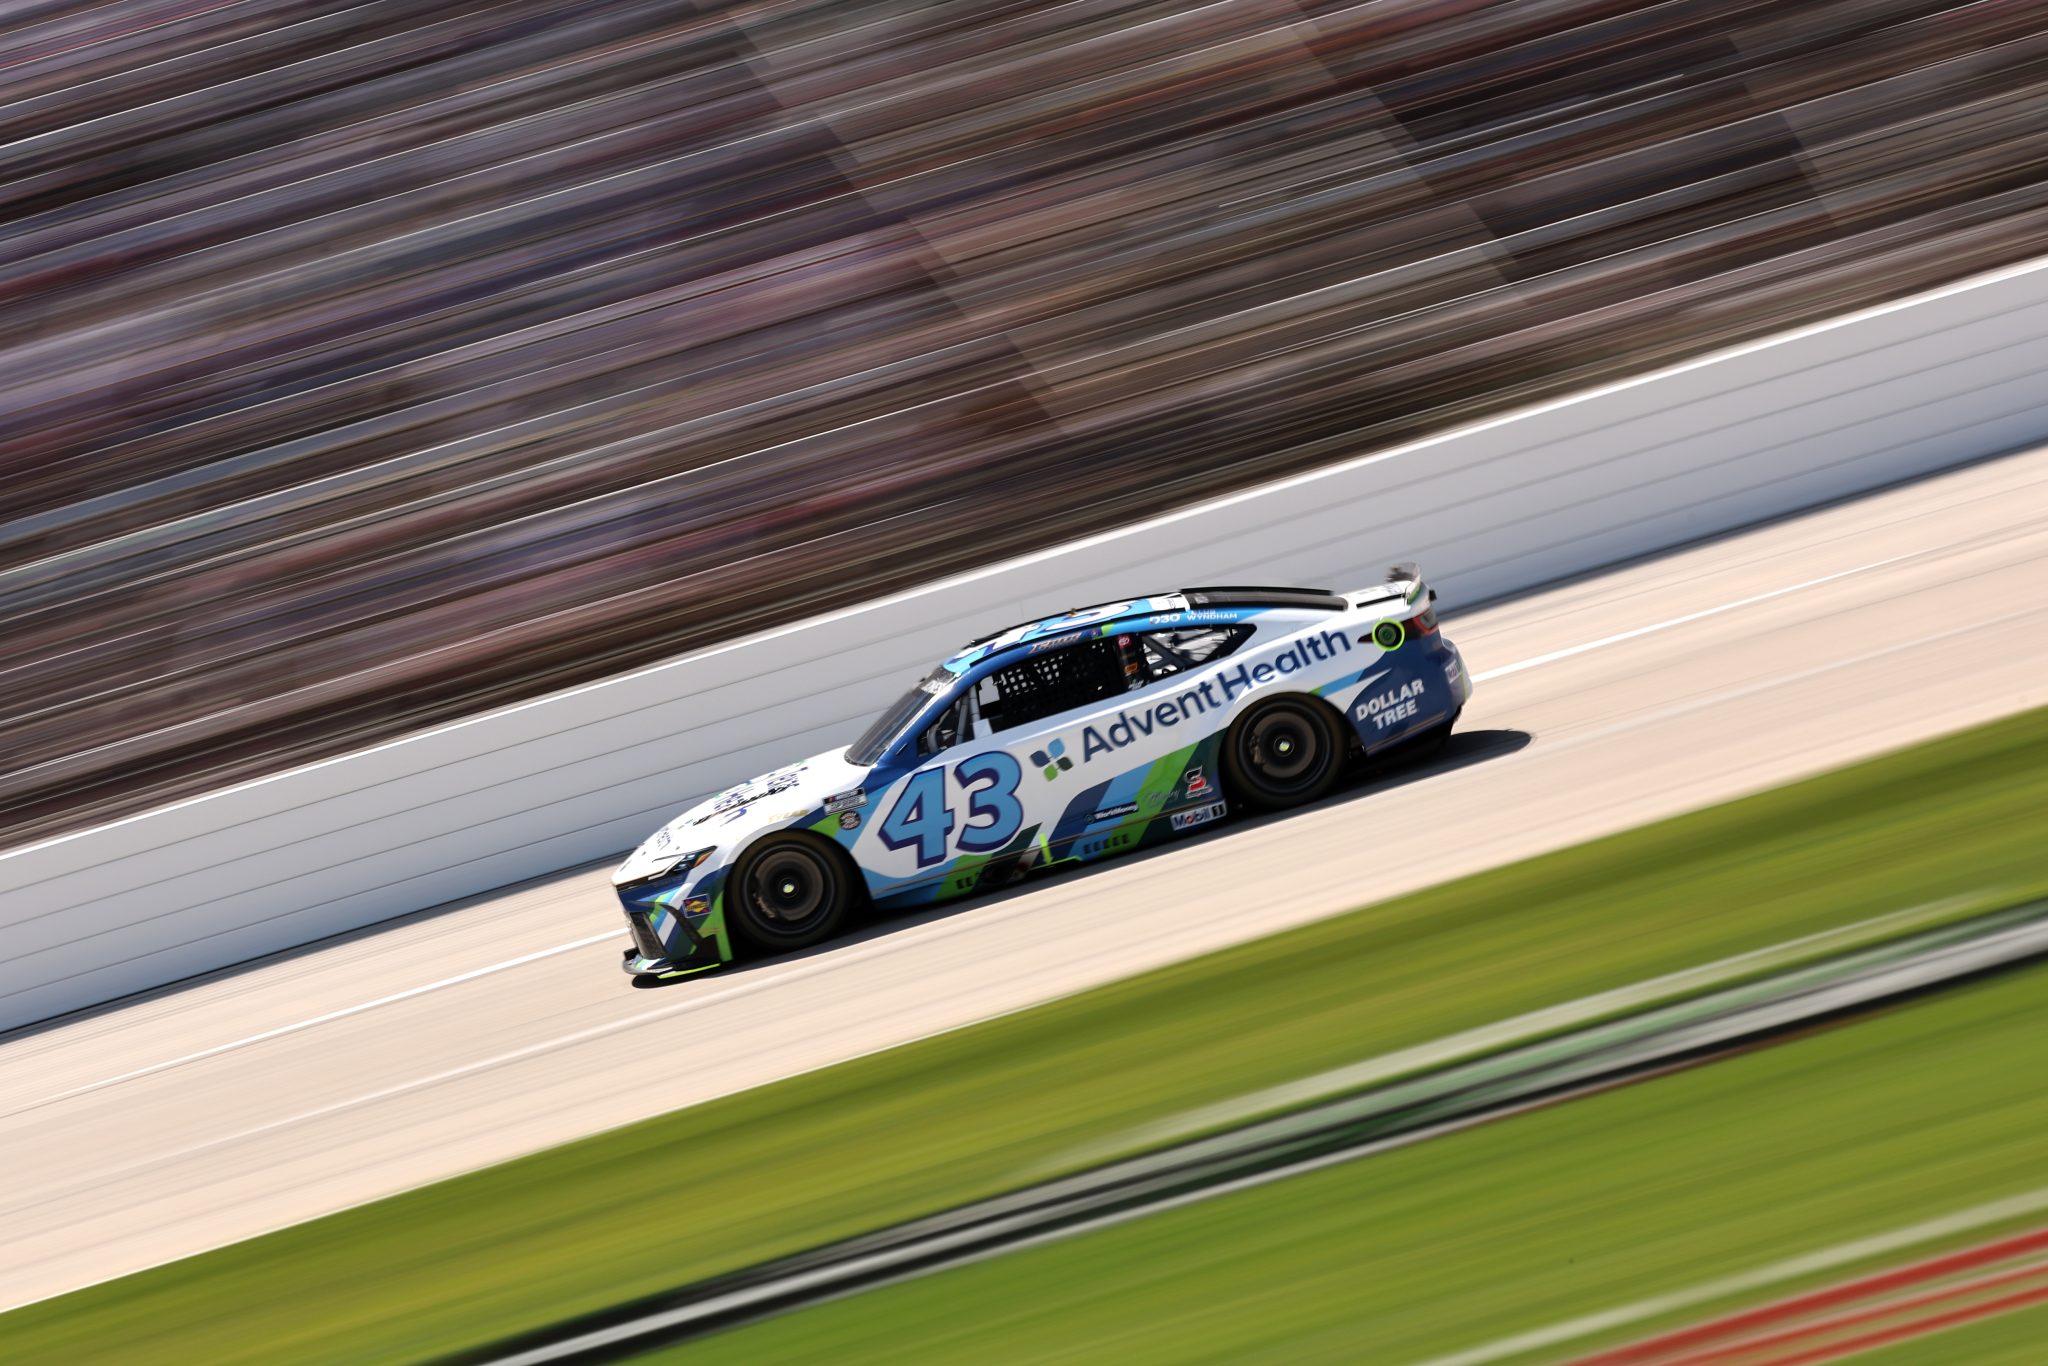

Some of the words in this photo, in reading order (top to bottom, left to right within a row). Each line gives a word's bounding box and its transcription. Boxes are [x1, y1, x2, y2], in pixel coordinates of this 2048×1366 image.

[1186, 612, 1238, 621] WYNDHAM
[1082, 630, 1352, 763] AdventHealth
[1355, 679, 1424, 721] DOLLAR
[1372, 699, 1418, 730] TREE
[877, 751, 1024, 869] 43
[1173, 807, 1210, 827] Mobil
